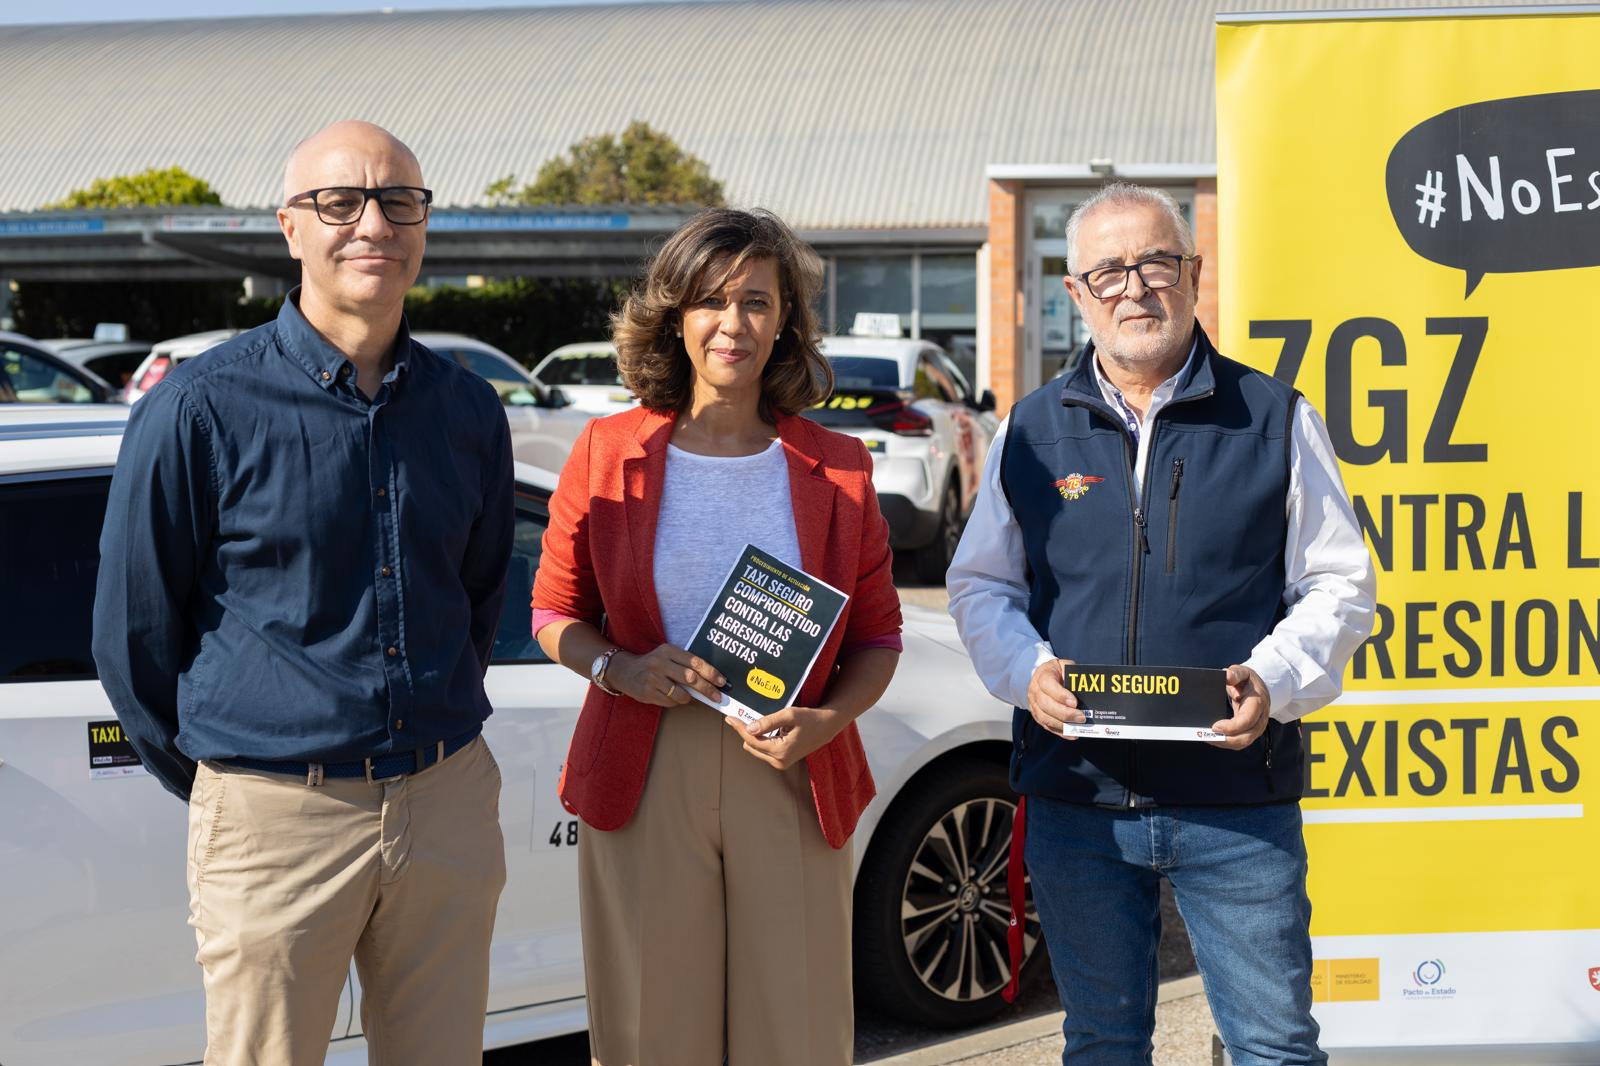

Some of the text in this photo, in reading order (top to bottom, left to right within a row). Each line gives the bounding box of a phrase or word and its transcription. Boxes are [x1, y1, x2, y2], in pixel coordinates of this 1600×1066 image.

[1352, 493, 1537, 572] NTRA
[733, 581, 822, 638] COMPROMETIDO
[742, 565, 814, 612] TAXI SEGURO
[714, 612, 784, 658] AGRESIONES
[724, 596, 793, 642] CONTRA LAS
[1353, 599, 1600, 680] RESION
[706, 628, 758, 665] SEXISTAS
[749, 673, 782, 694] #NoEsNo
[1069, 673, 1180, 695] TAXI SEGURO
[91, 726, 120, 744] TAXI
[1303, 716, 1580, 798] EXISTAS
[549, 820, 578, 847] 48
[1403, 988, 1424, 996] Pacto
[1431, 987, 1456, 995] Estado
